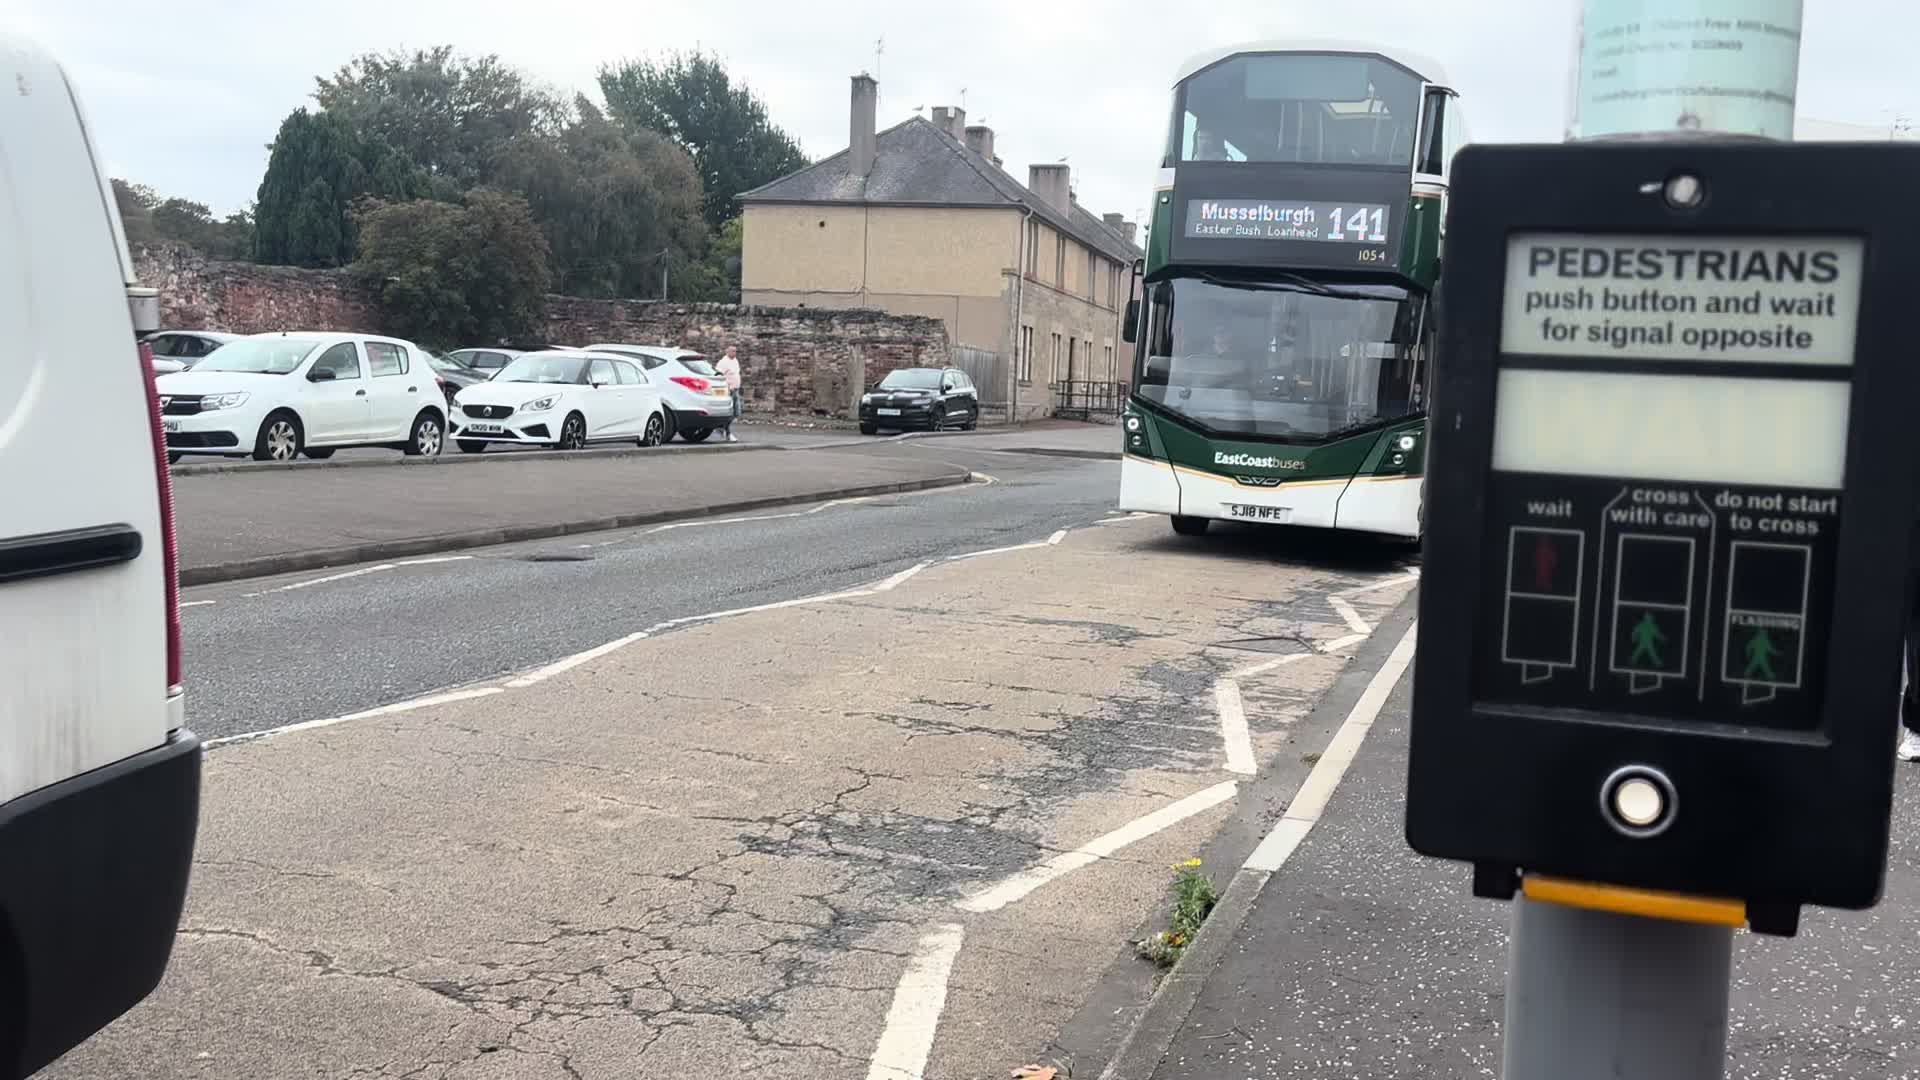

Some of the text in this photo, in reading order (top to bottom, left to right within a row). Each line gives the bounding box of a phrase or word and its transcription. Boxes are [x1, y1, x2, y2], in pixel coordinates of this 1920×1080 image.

[1195, 223, 1318, 239] Easter Bush Loanhead
[1202, 203, 1385, 242] Musselburgh 141
[1358, 250, 1385, 261] 1054
[1528, 247, 1839, 284] PEDESTRIANS
[1525, 288, 1836, 317] push button and wait
[1542, 317, 1814, 352] for signal opposite
[1632, 487, 1690, 505] cross
[1715, 490, 1838, 515] do not start
[1231, 505, 1281, 519] SJ18 NFE
[1527, 500, 1573, 518] wait
[1610, 506, 1711, 528] with care
[1730, 512, 1820, 536] to cross
[1730, 613, 1801, 630] FLASHING
